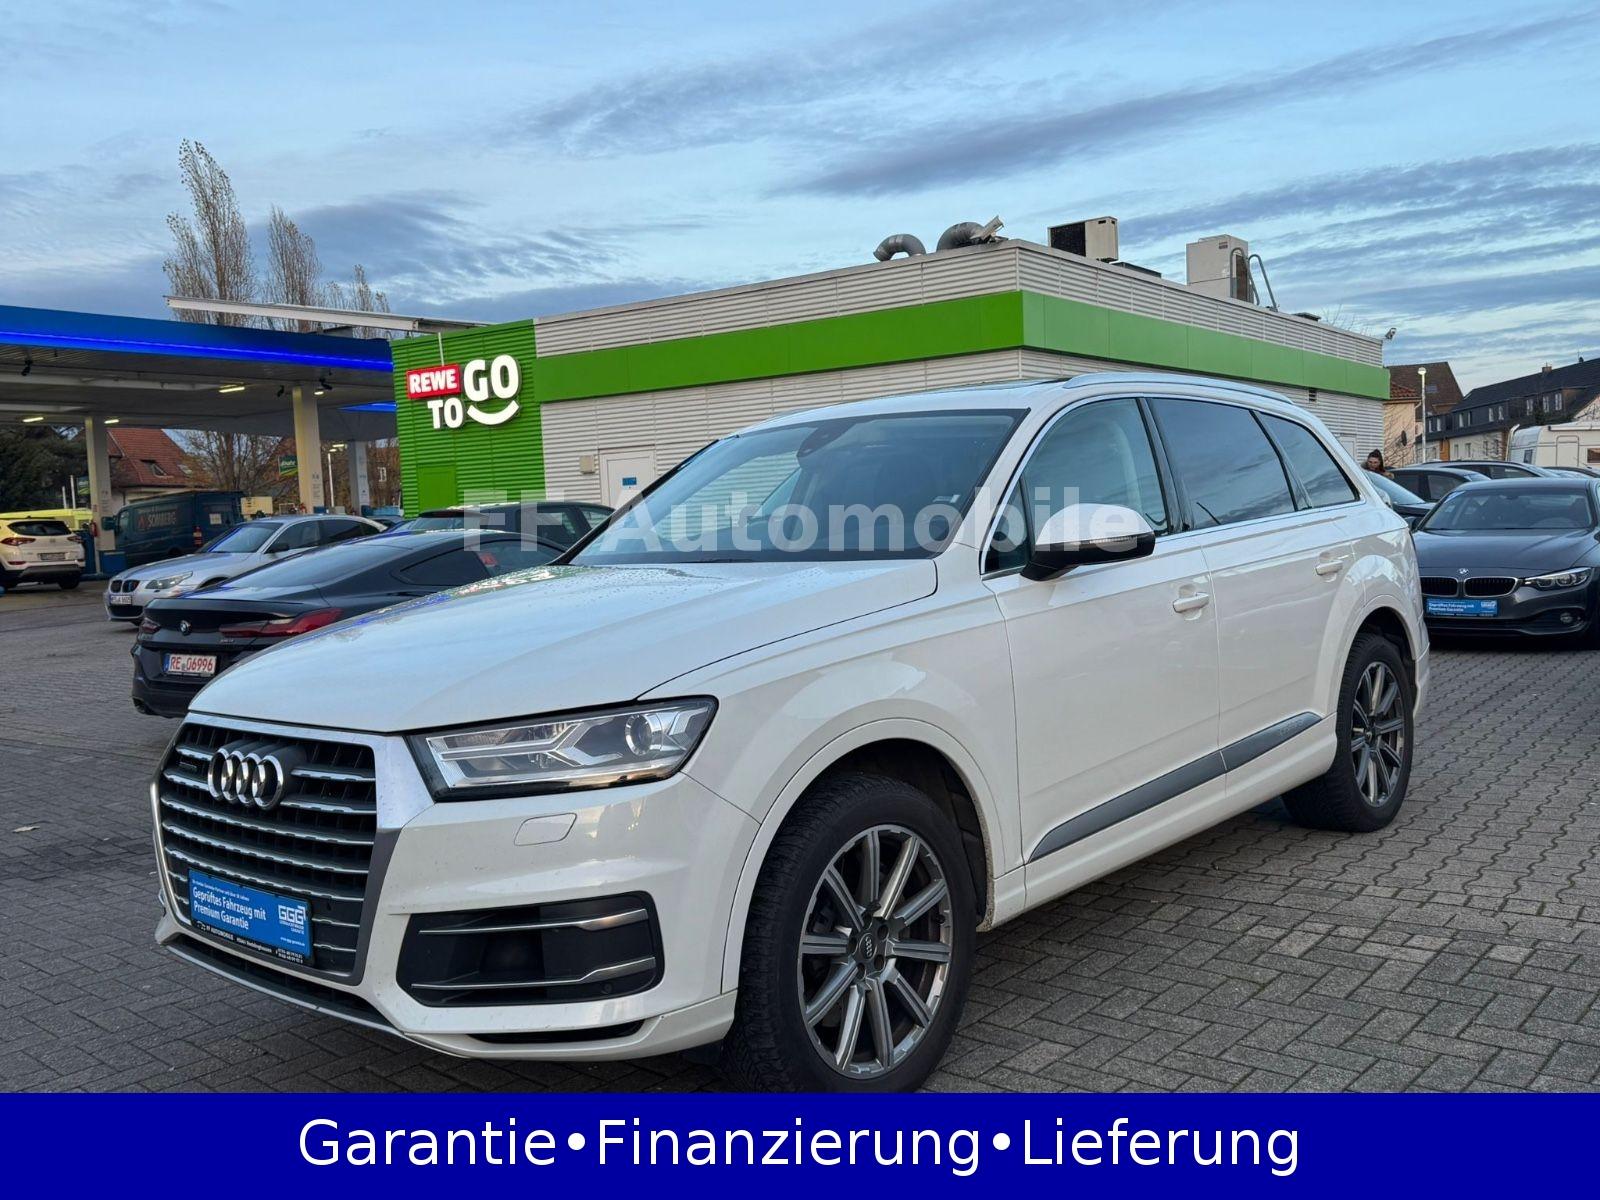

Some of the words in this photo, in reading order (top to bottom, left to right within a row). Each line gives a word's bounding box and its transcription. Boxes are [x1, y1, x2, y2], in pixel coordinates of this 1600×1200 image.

[409, 369, 457, 393] REWE
[427, 398, 463, 429] TO
[463, 354, 519, 402] GO
[171, 656, 181, 670] RE
[187, 657, 213, 671] 06996
[193, 886, 222, 907] Geprüftes
[223, 897, 252, 920] Fahrzeug
[253, 907, 267, 920] mit
[194, 900, 221, 920] Premium
[221, 911, 249, 930] Garantie
